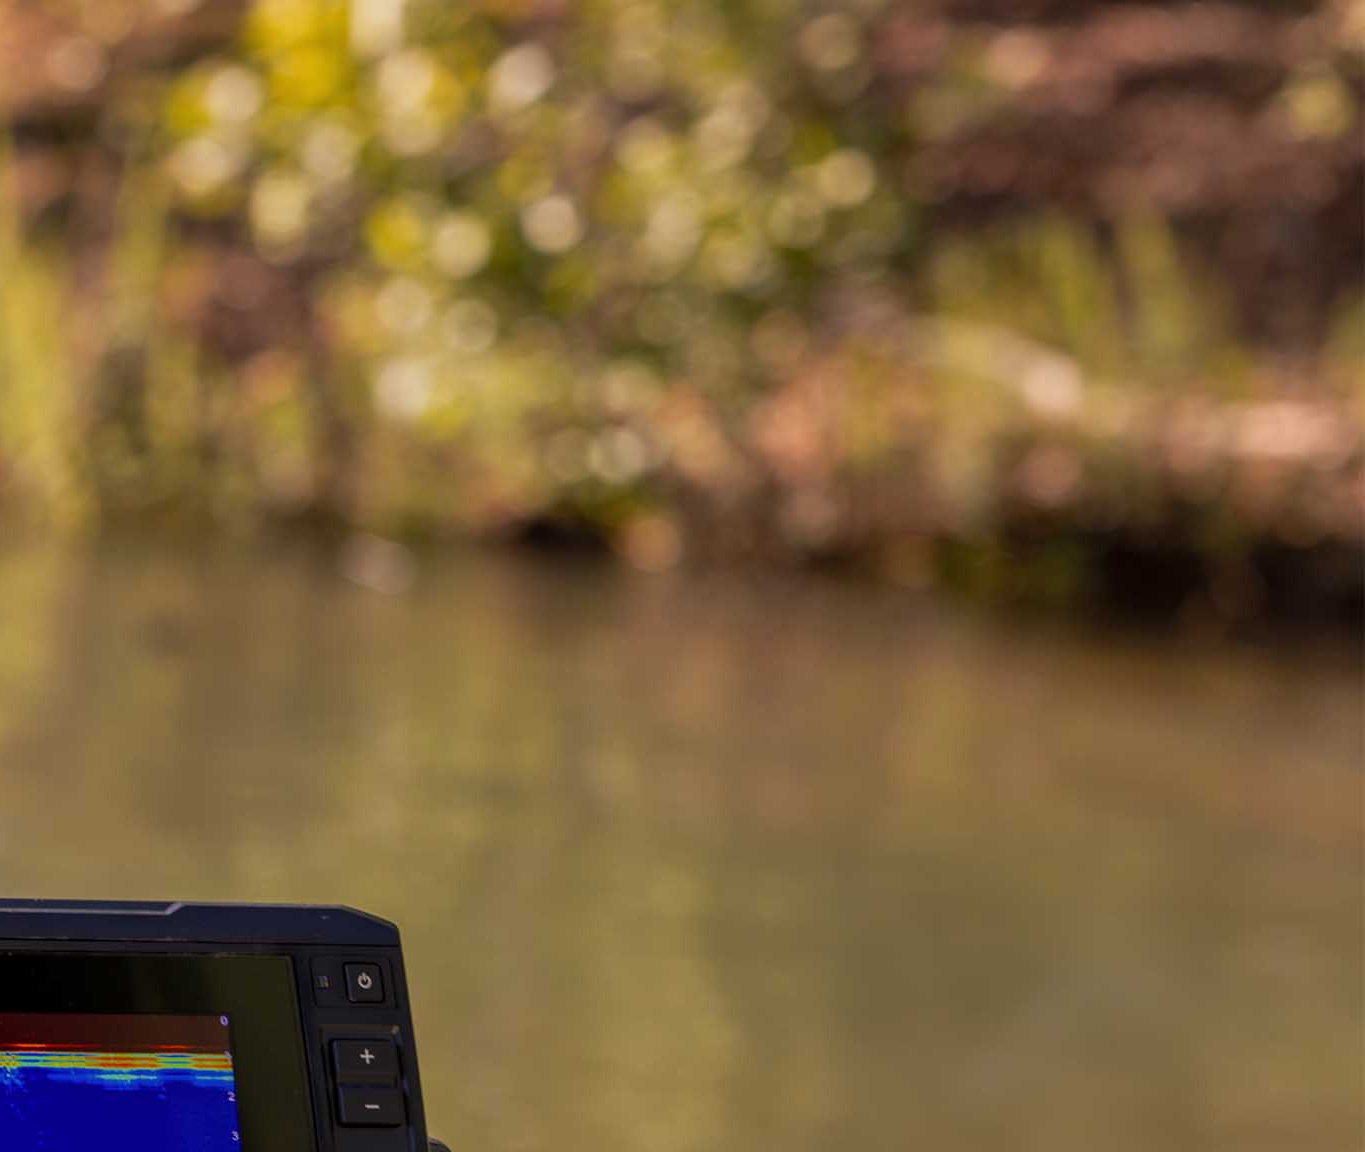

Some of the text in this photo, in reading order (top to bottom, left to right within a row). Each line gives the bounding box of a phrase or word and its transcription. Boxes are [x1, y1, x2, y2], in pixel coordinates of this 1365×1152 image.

[220, 1015, 229, 1026] 0
[228, 1091, 236, 1102] 2
[231, 1130, 240, 1141] 3
